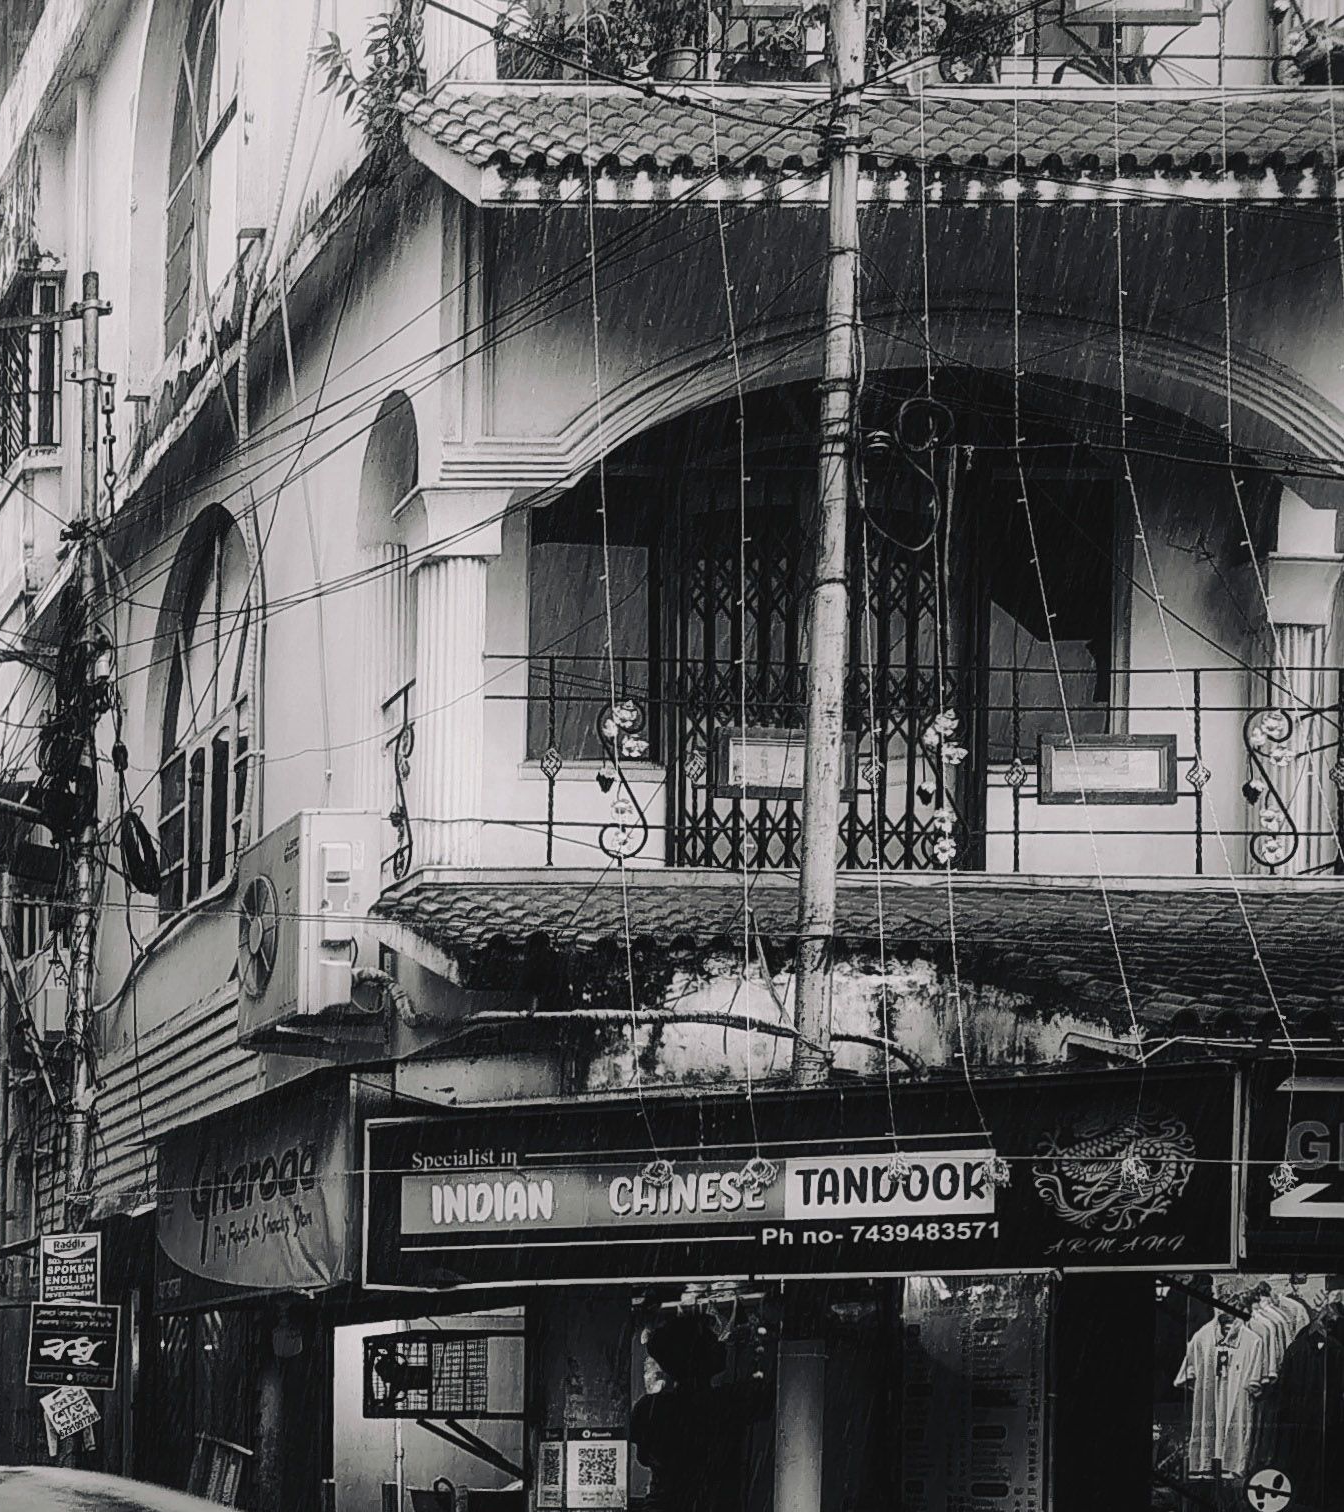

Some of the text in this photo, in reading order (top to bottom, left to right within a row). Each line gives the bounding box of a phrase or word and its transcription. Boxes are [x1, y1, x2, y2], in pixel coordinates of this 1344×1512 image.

[411, 1148, 518, 1171] Specialist in
[431, 1179, 554, 1225] INDIAN
[608, 1172, 766, 1217] CHINESE
[761, 1220, 1000, 1246] Ph no- 7439483571
[1043, 1233, 1186, 1255] ARMANI
[53, 1238, 87, 1251] Raddix
[44, 1273, 95, 1286] ENGLISH
[46, 1263, 94, 1275] SPOKEN
